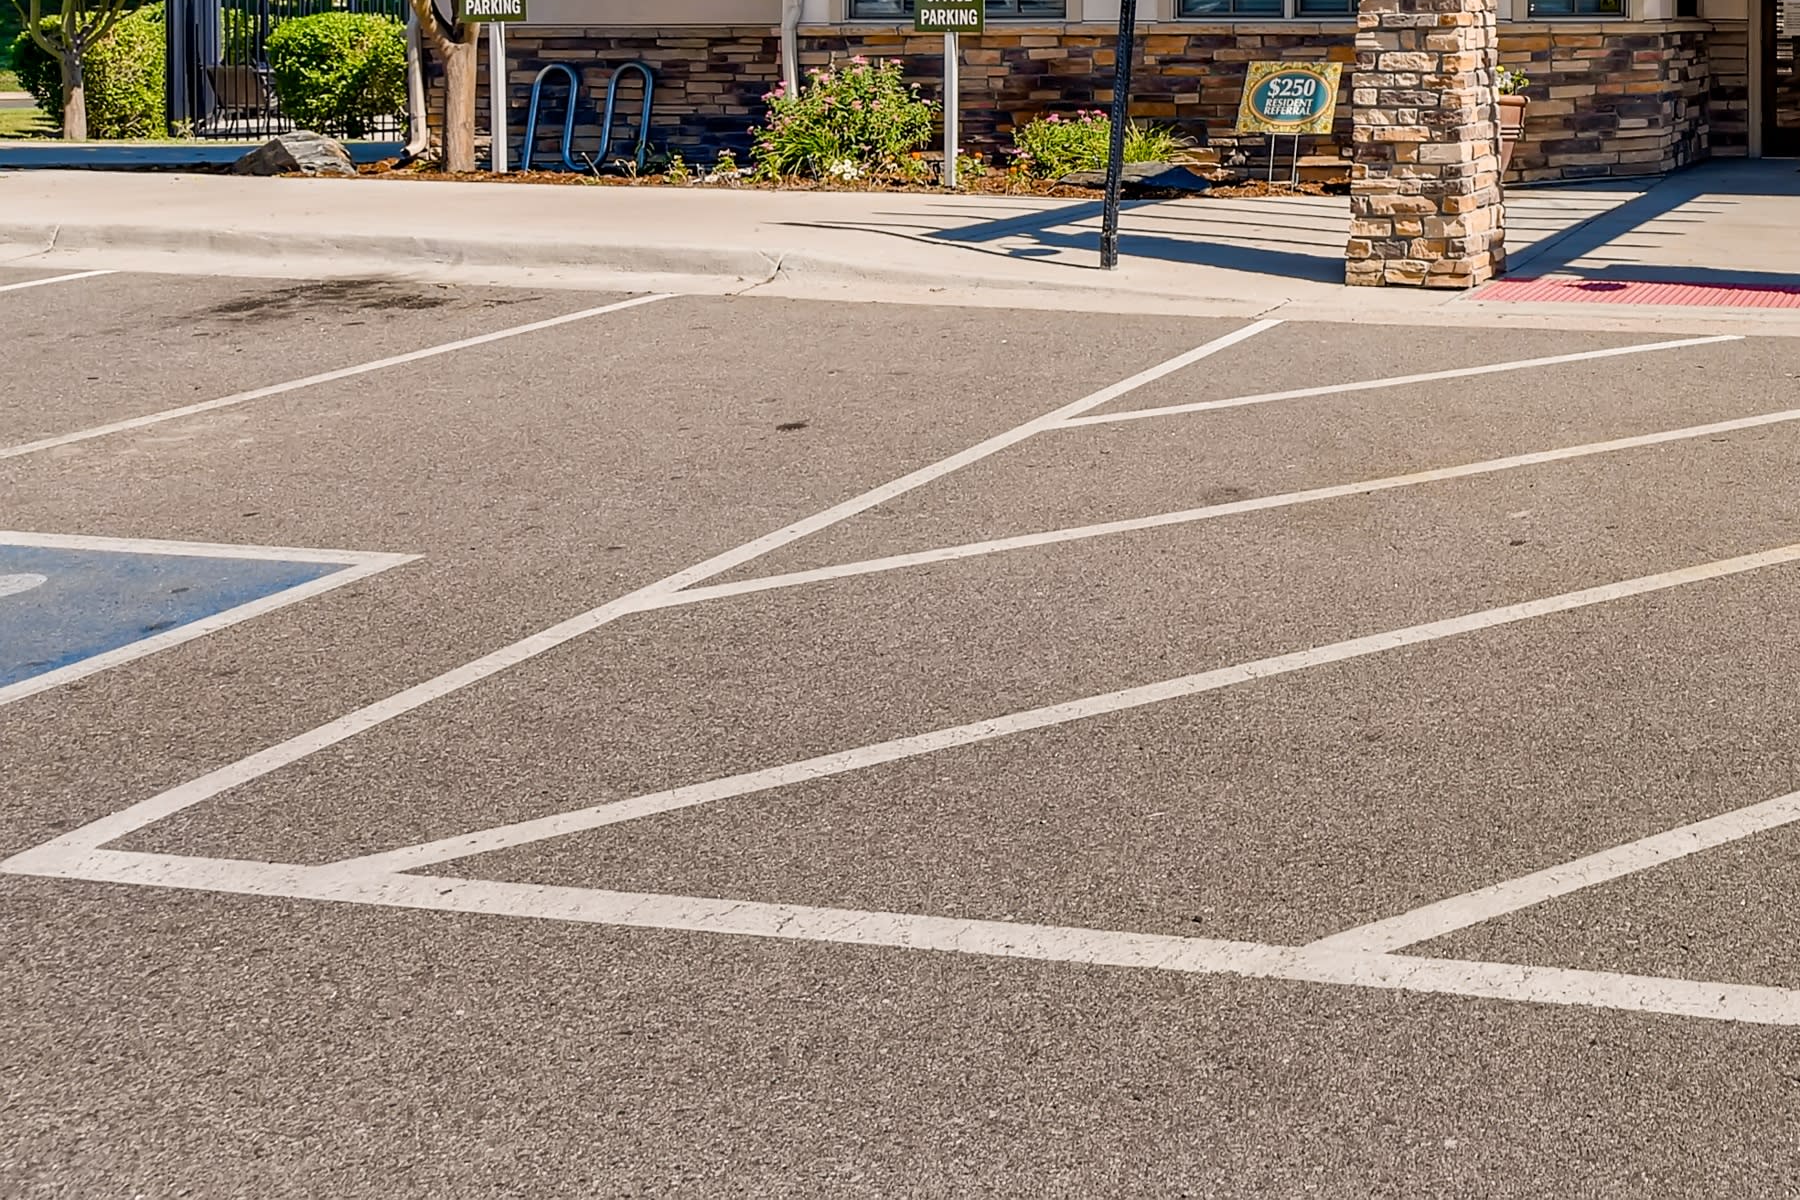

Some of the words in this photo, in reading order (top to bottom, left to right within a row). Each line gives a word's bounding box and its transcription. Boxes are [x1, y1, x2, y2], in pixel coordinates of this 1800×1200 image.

[920, 8, 978, 26] PARKING
[1267, 78, 1317, 99] $250
[1265, 98, 1314, 108] RESIDENT
[1263, 106, 1312, 116] REFERRAL
